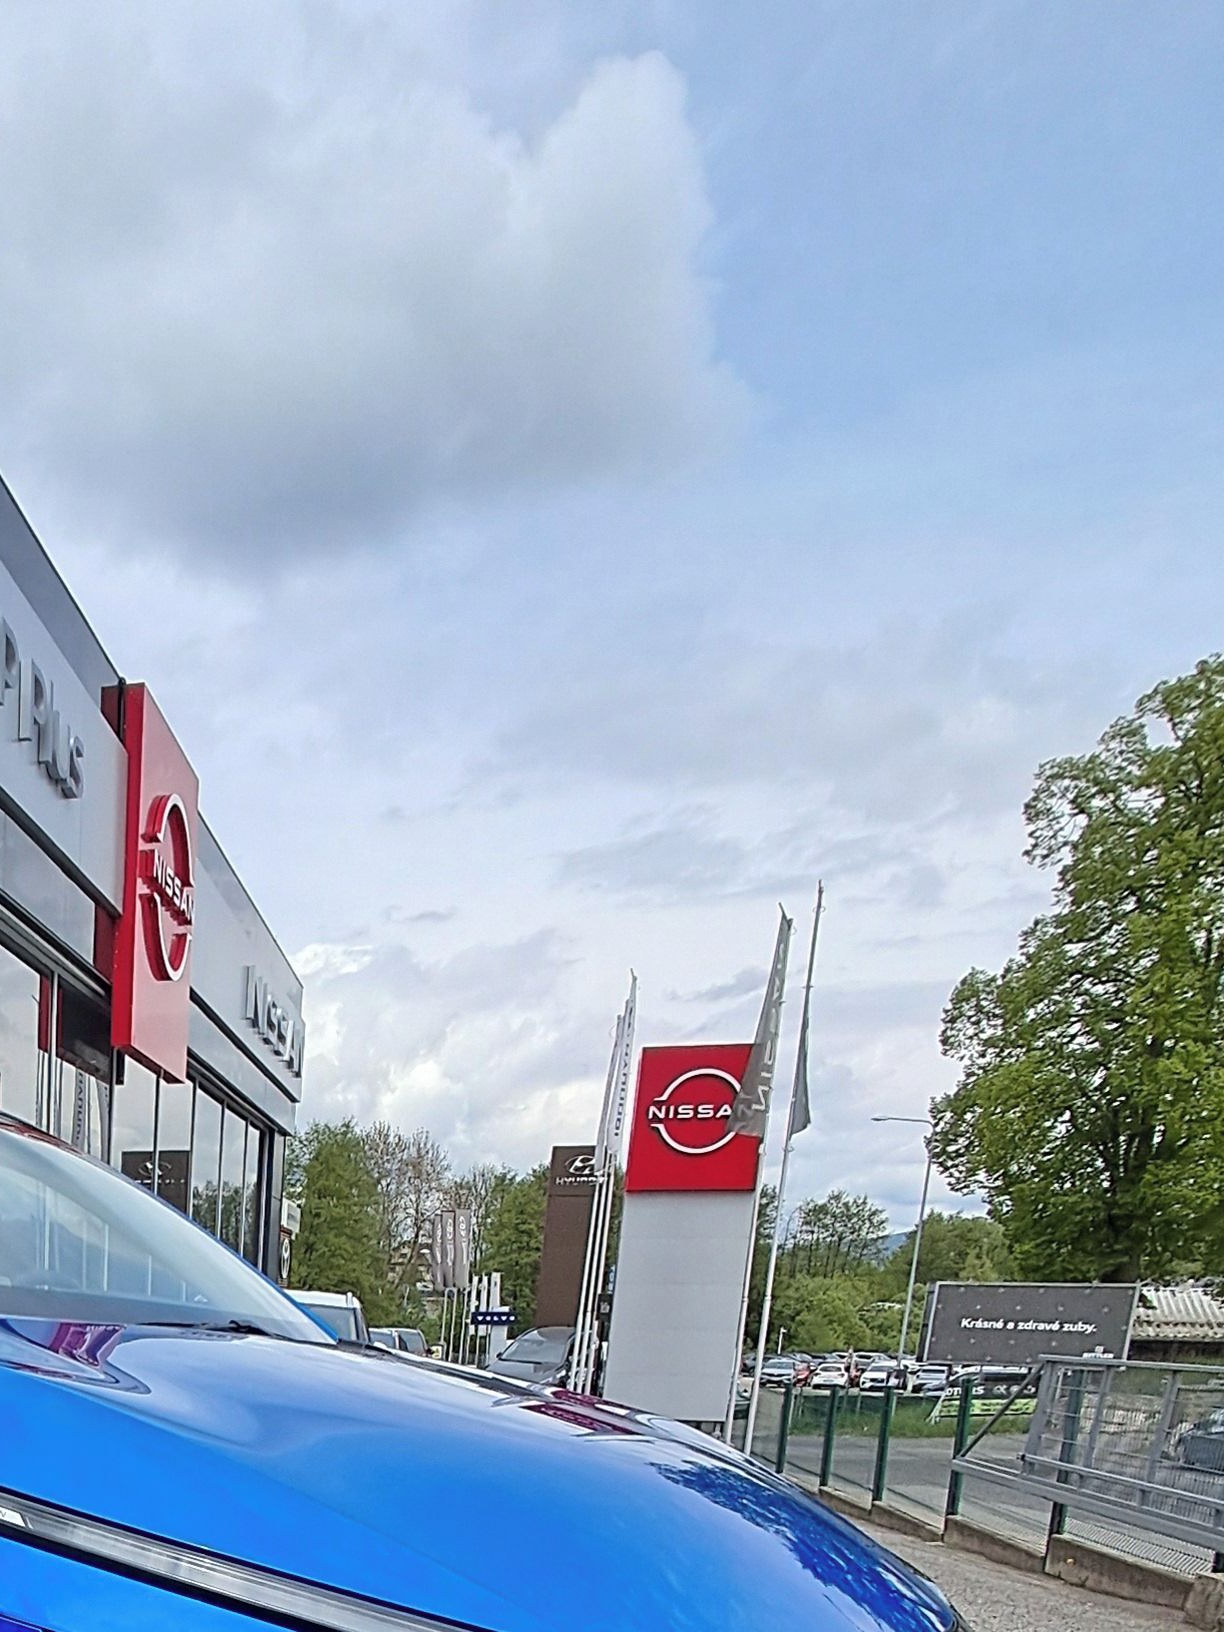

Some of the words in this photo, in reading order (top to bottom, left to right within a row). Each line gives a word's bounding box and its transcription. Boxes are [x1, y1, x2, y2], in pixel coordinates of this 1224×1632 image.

[648, 1103, 734, 1120] NISSA
[960, 1318, 1003, 1329] Krásné
[1006, 1321, 1015, 1330] a
[1017, 1319, 1060, 1332] zdravé
[1062, 1321, 1098, 1334] zuby.
